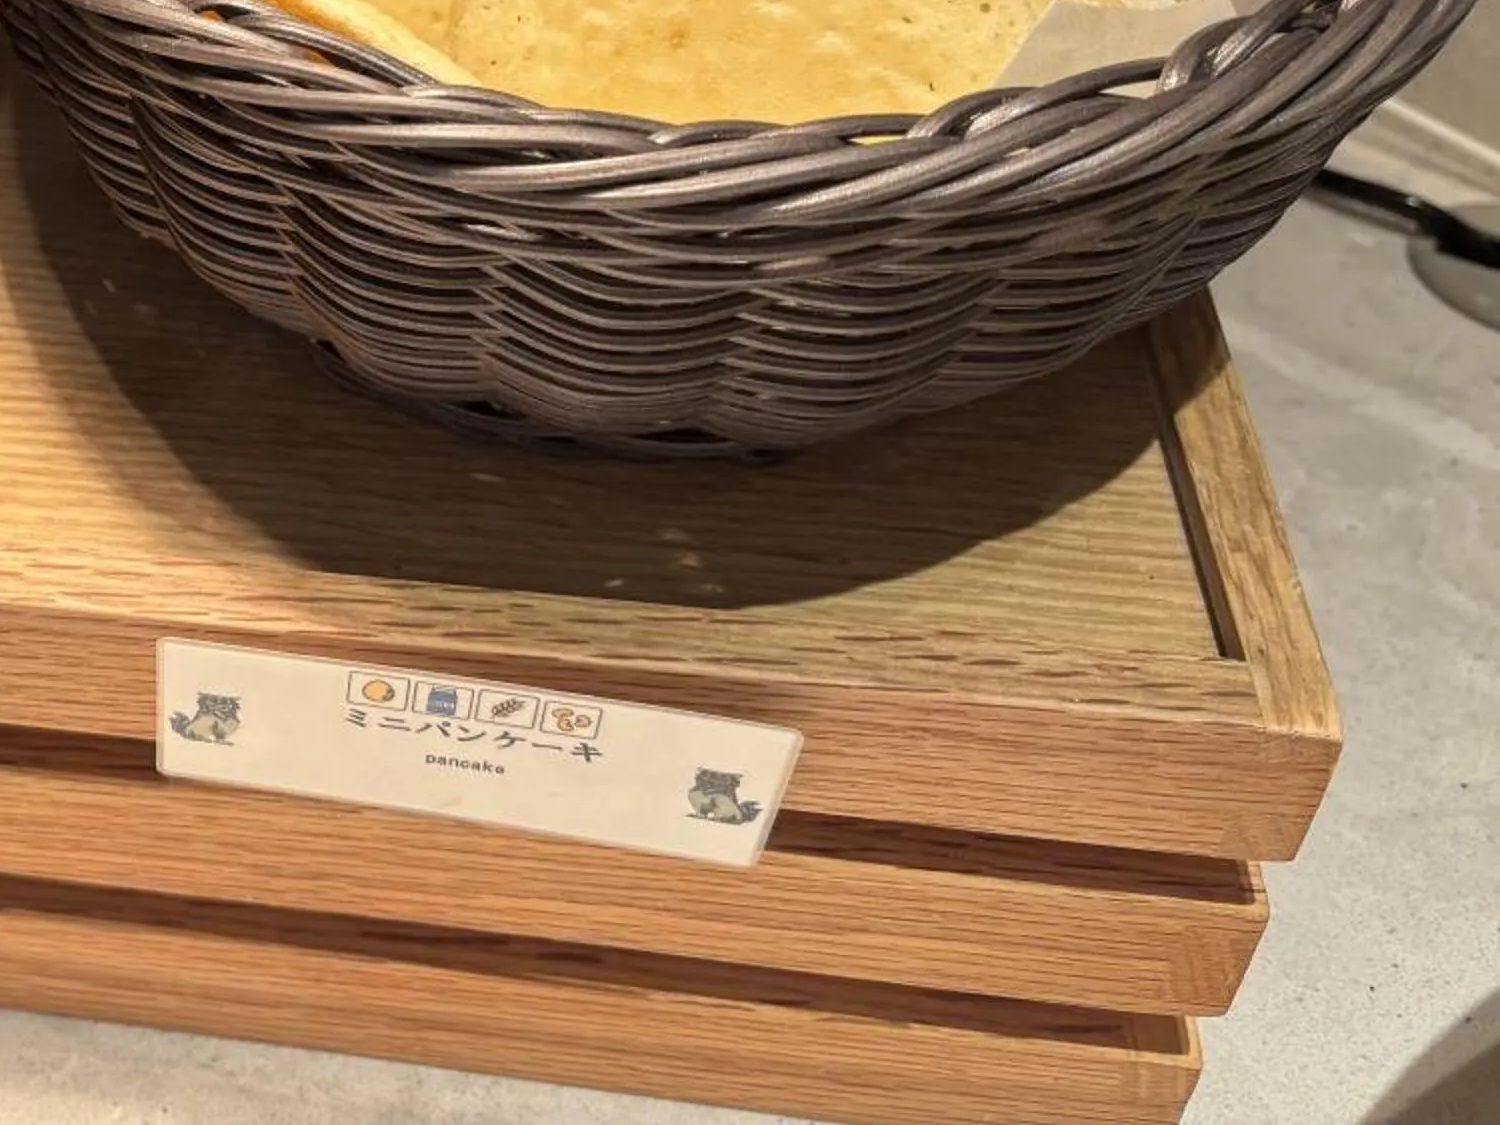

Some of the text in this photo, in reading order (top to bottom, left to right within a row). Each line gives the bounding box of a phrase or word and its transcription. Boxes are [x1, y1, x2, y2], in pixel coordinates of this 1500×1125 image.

[345, 708, 603, 763] ミニパンケーキ
[425, 754, 505, 775] pancake
